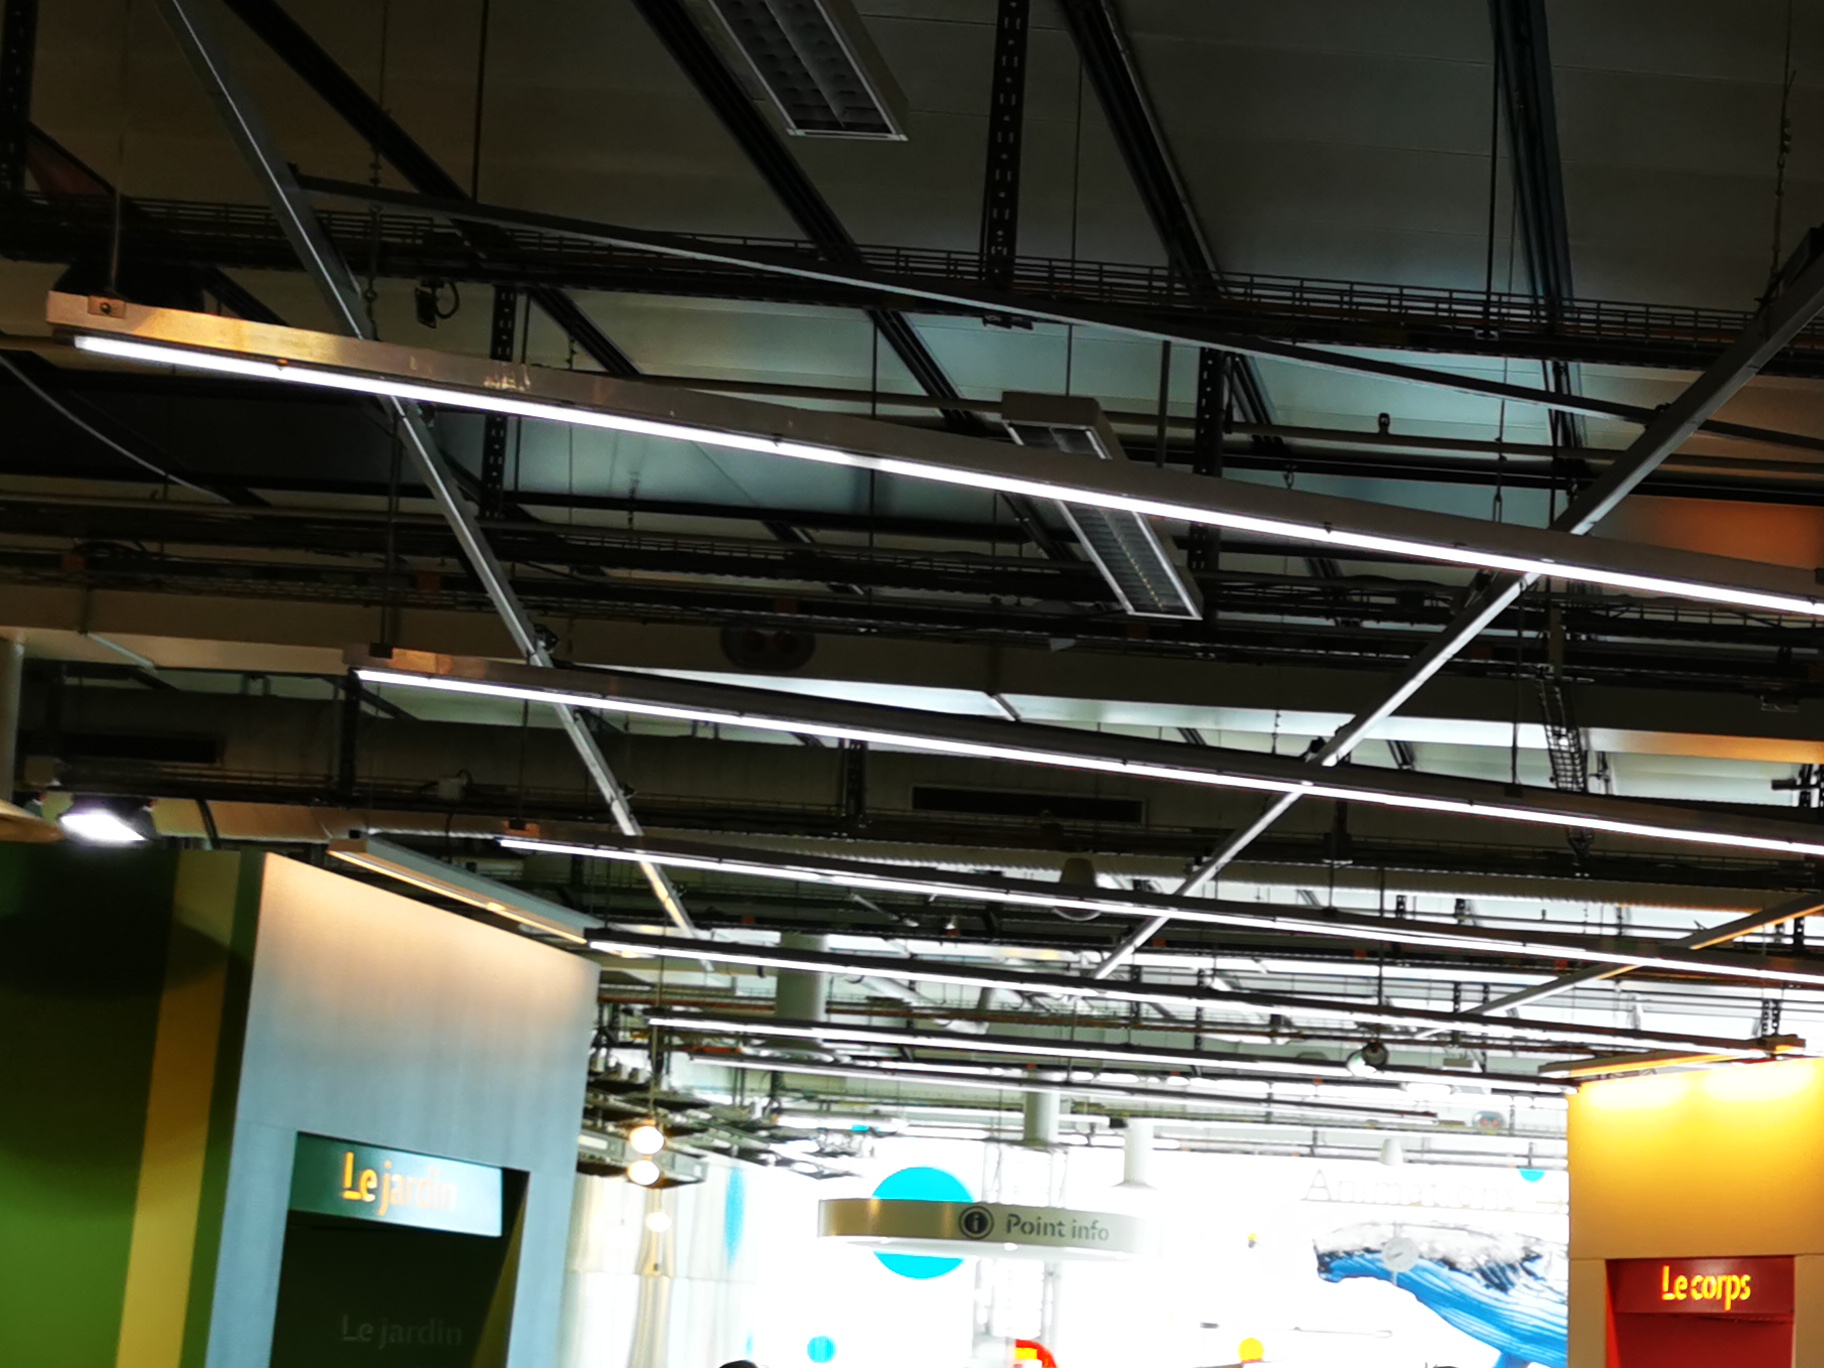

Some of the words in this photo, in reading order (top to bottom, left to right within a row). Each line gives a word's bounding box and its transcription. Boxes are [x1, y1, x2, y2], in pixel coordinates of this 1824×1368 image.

[342, 1152, 378, 1202] Le
[1006, 1213, 1067, 1238] Point
[1071, 1217, 1110, 1242] info
[1661, 1263, 1688, 1301] Le
[1689, 1272, 1752, 1312] corps
[341, 1313, 374, 1342] Le
[377, 1316, 463, 1350] jardin
